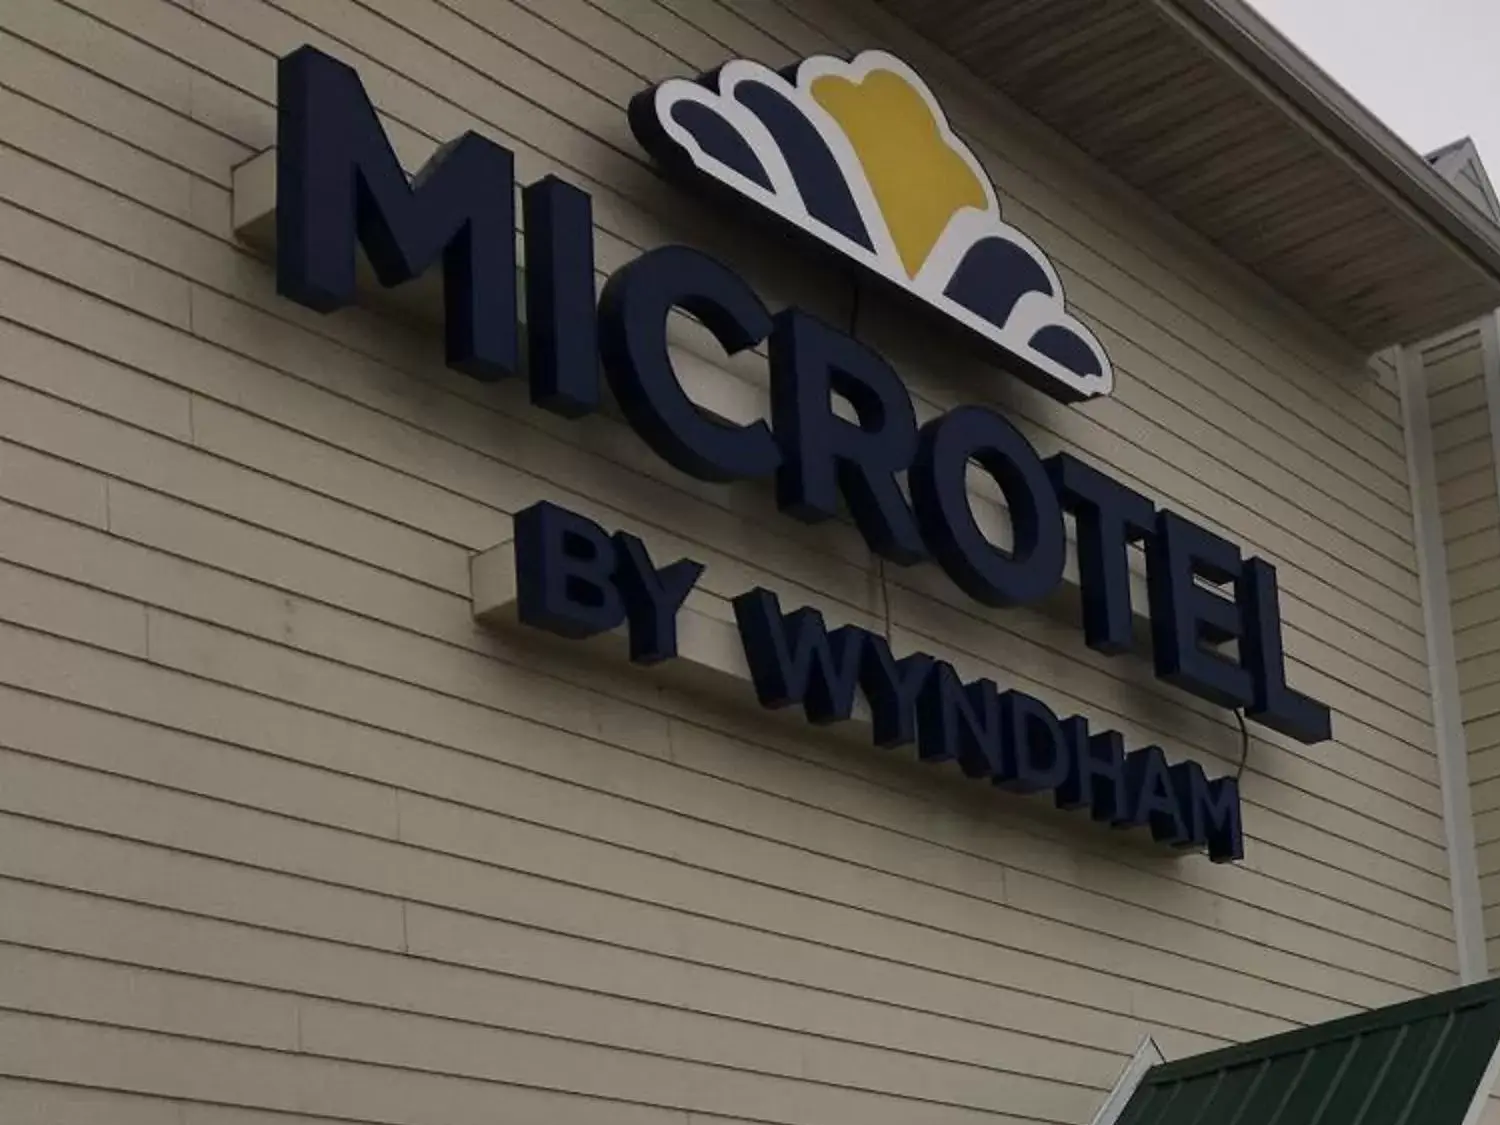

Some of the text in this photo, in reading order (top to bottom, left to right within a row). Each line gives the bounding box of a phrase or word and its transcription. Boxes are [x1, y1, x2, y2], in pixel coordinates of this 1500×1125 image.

[278, 44, 1331, 743] MICROTEL
[514, 500, 1244, 863] BY WYNDHAM
